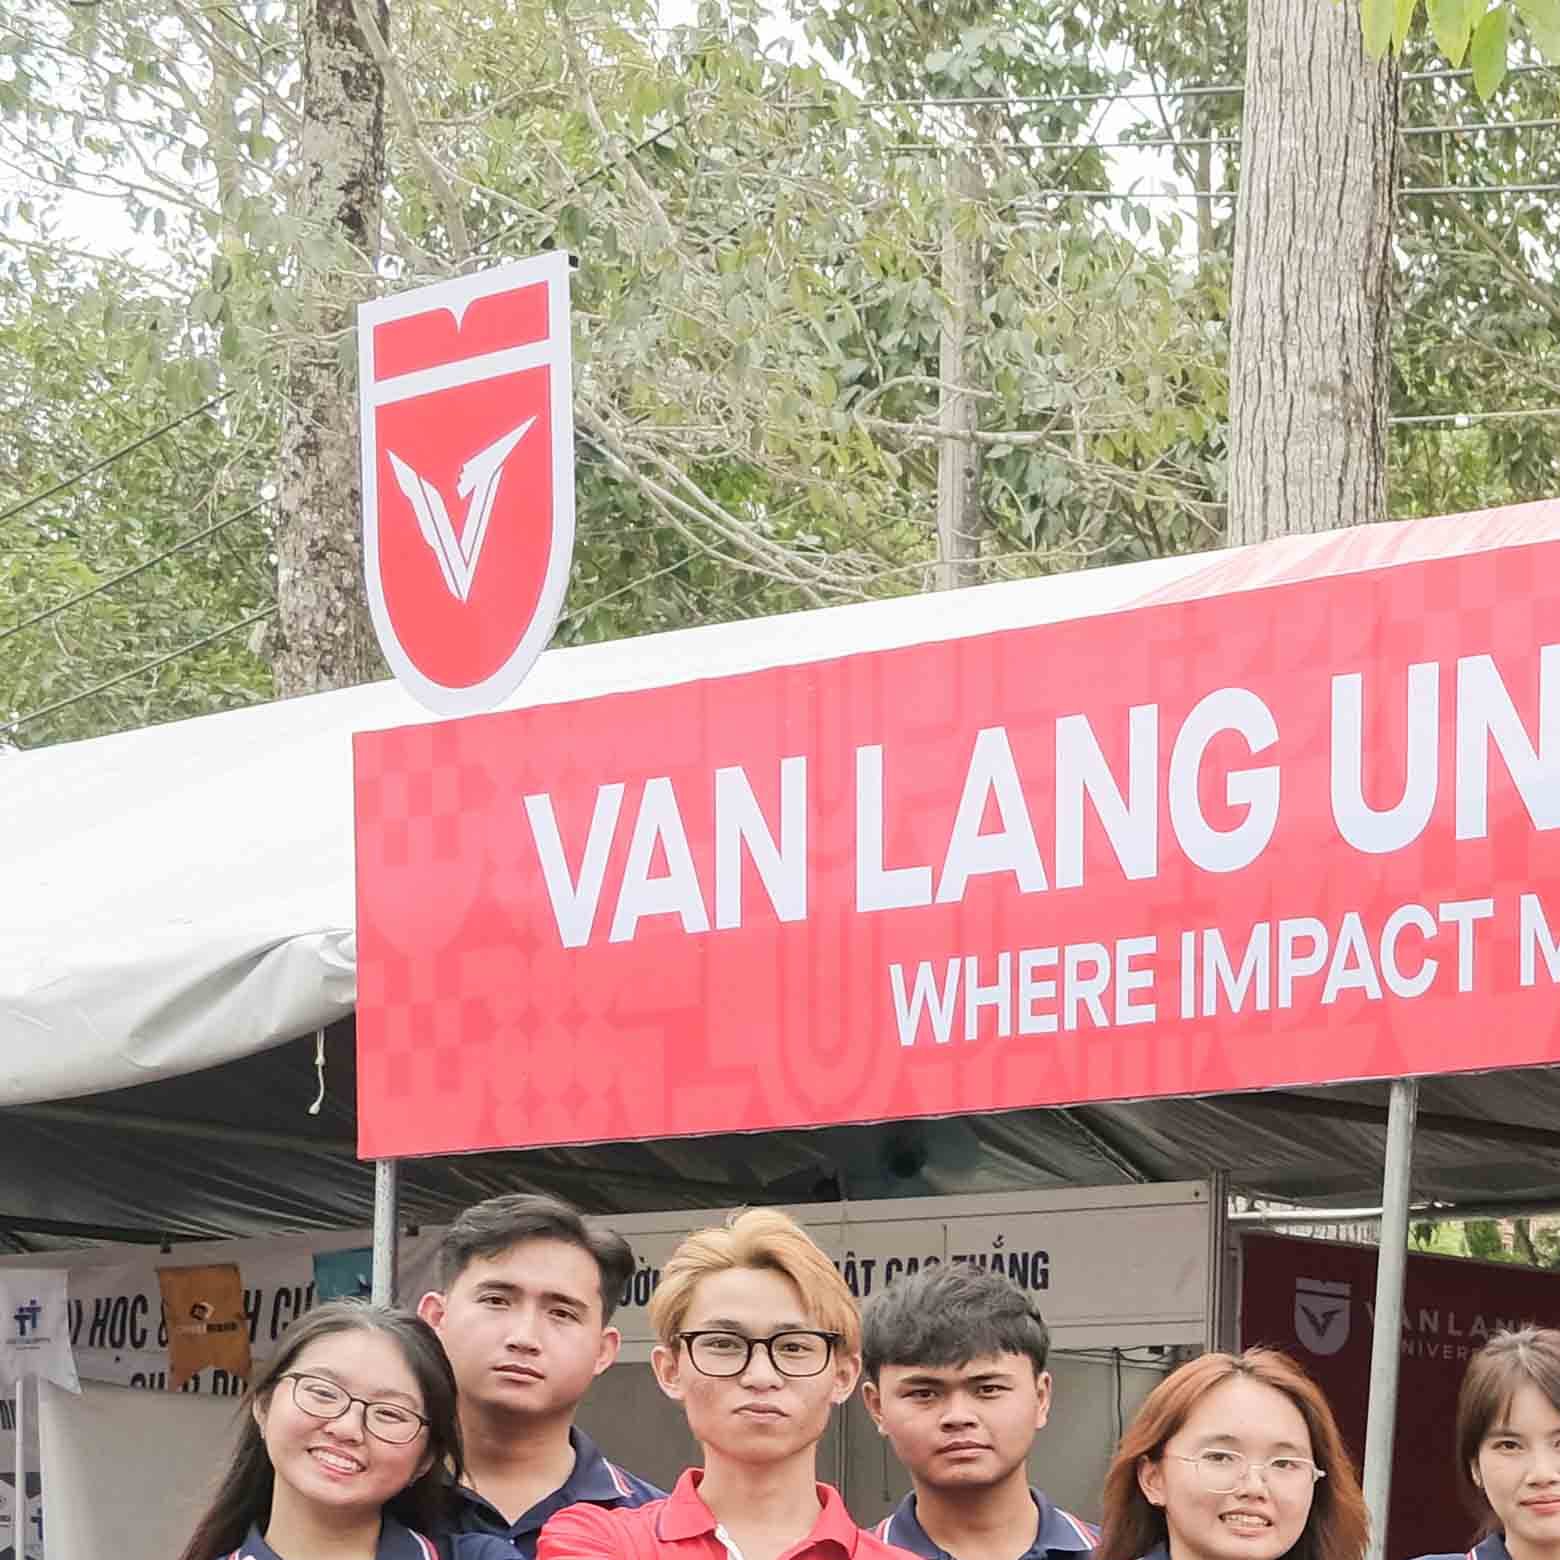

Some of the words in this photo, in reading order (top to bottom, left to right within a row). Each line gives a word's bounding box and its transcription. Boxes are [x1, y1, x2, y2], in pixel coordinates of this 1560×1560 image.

[523, 755, 807, 949] VAN
[855, 686, 1281, 913] LANG
[889, 934, 1157, 1047] WHERE
[1179, 897, 1494, 1019] IMPACT
